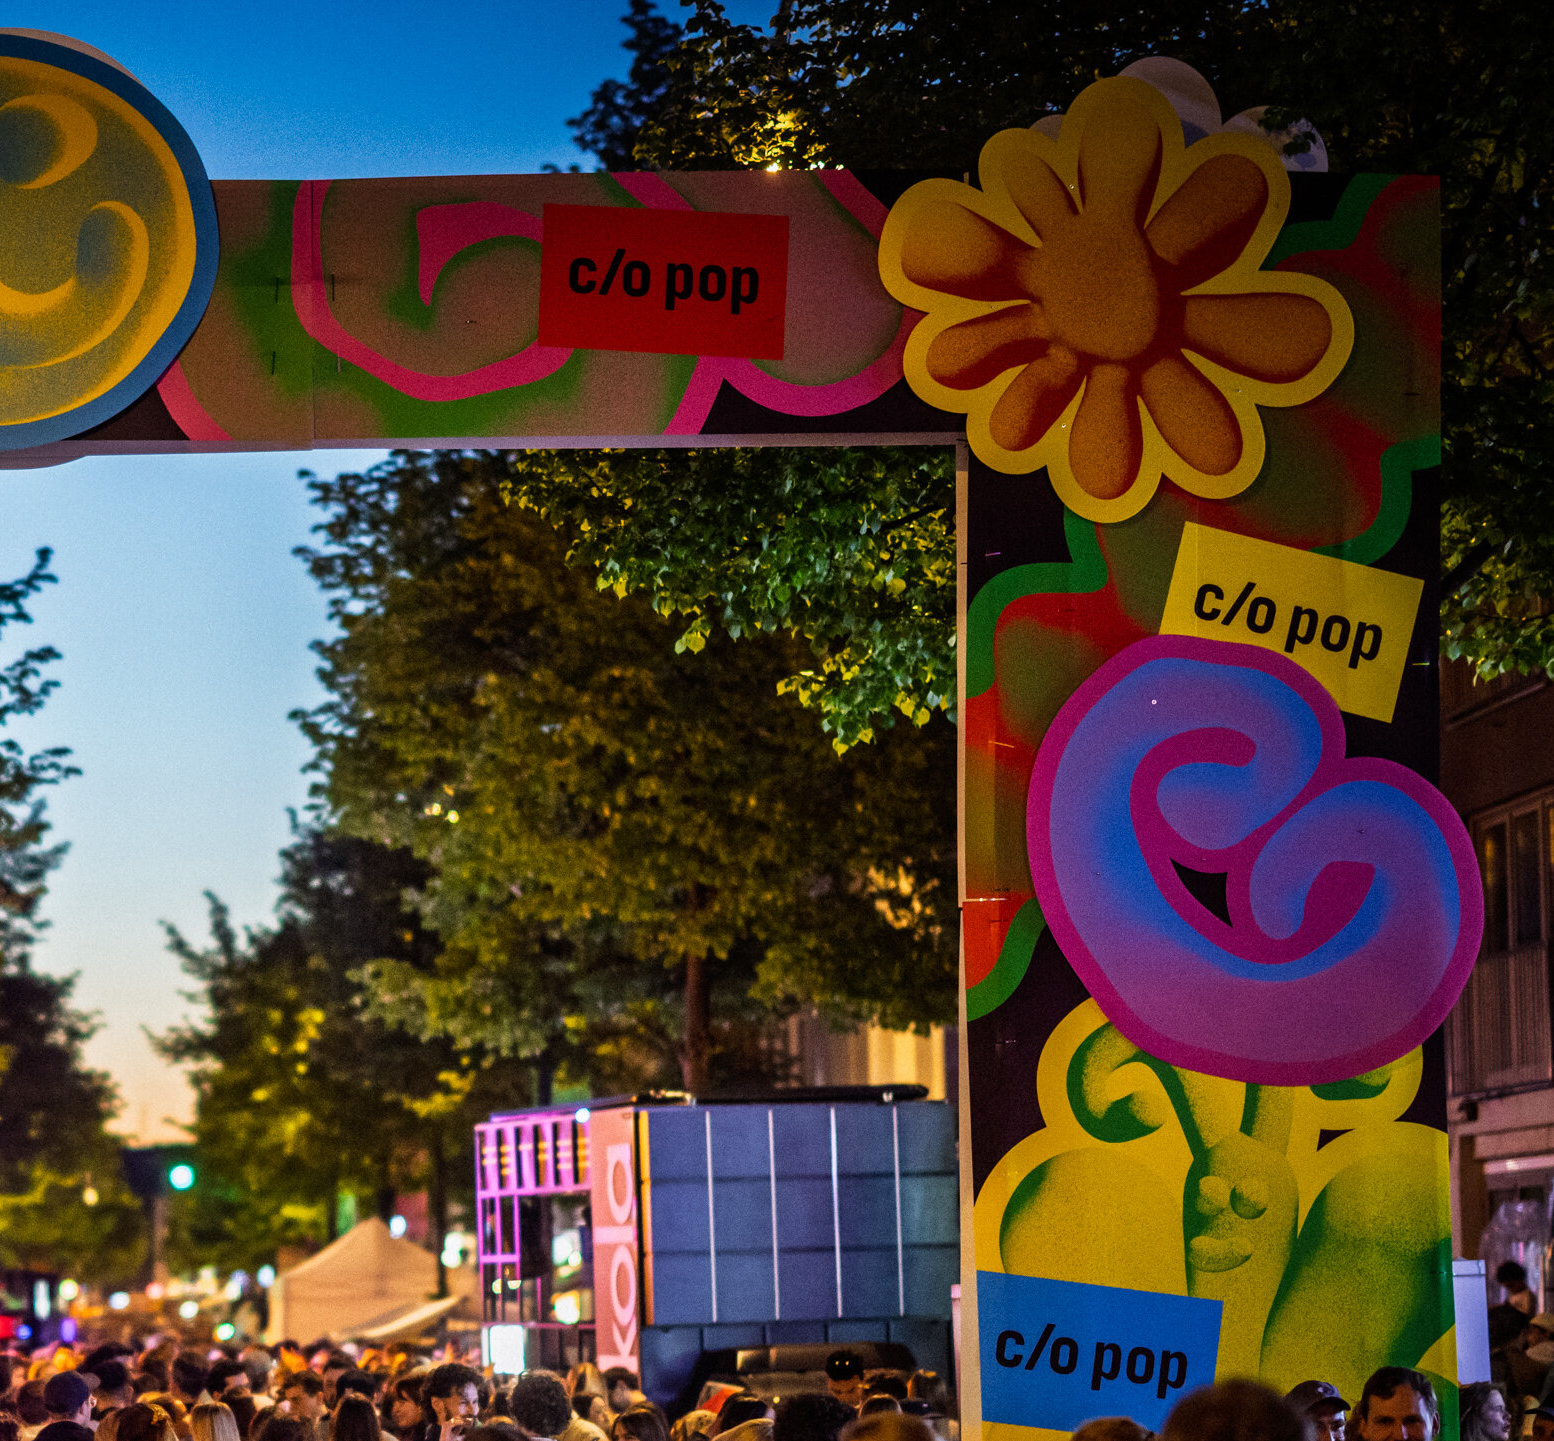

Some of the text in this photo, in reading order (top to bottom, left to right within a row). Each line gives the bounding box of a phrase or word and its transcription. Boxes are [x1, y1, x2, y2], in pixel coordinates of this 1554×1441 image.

[569, 248, 759, 315] c/o pop
[1194, 581, 1383, 670] c/o pop
[995, 1323, 1188, 1399] c/o pop
